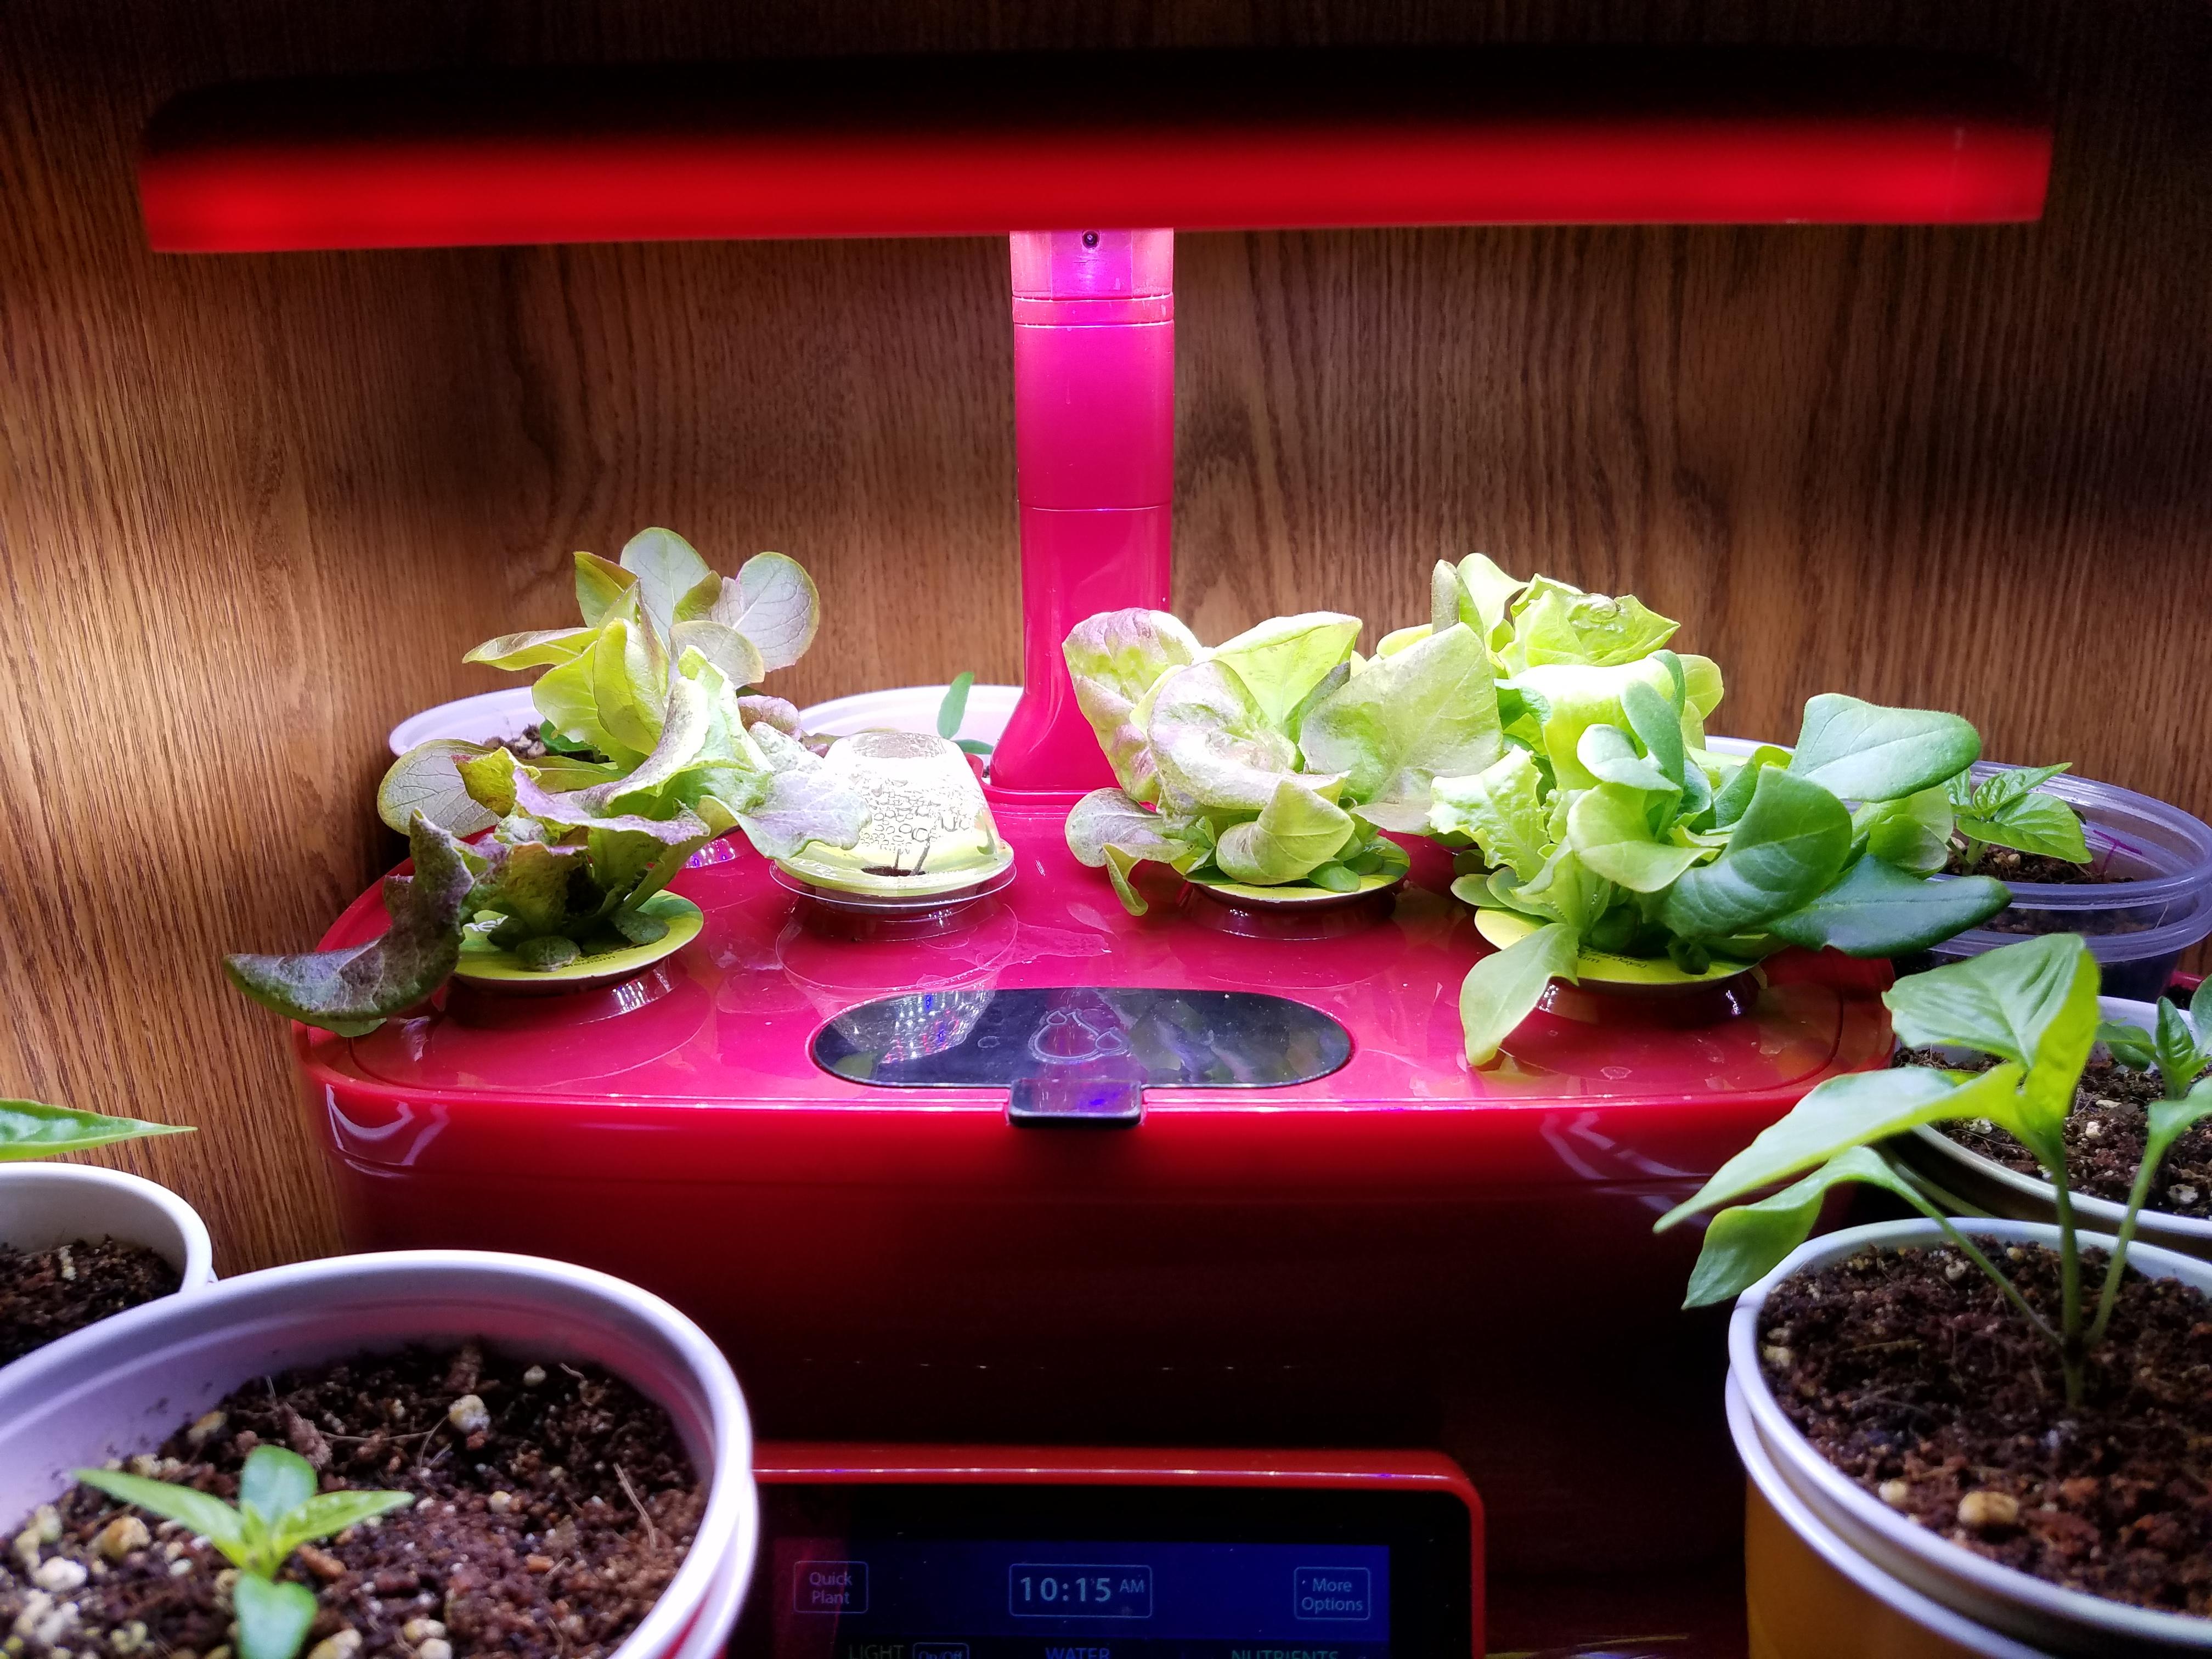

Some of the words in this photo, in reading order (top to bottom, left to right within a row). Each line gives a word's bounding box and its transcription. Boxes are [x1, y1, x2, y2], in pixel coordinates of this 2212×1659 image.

[809, 1571, 853, 1585] Quick
[1312, 1578, 1352, 1592] More
[1020, 1577, 1111, 1602] 10:15
[1120, 1578, 1145, 1593] AM
[812, 1590, 850, 1604] Plant
[1302, 1596, 1363, 1615] Options
[849, 1644, 905, 1659] LIGHT
[1045, 1647, 1109, 1659] WATER
